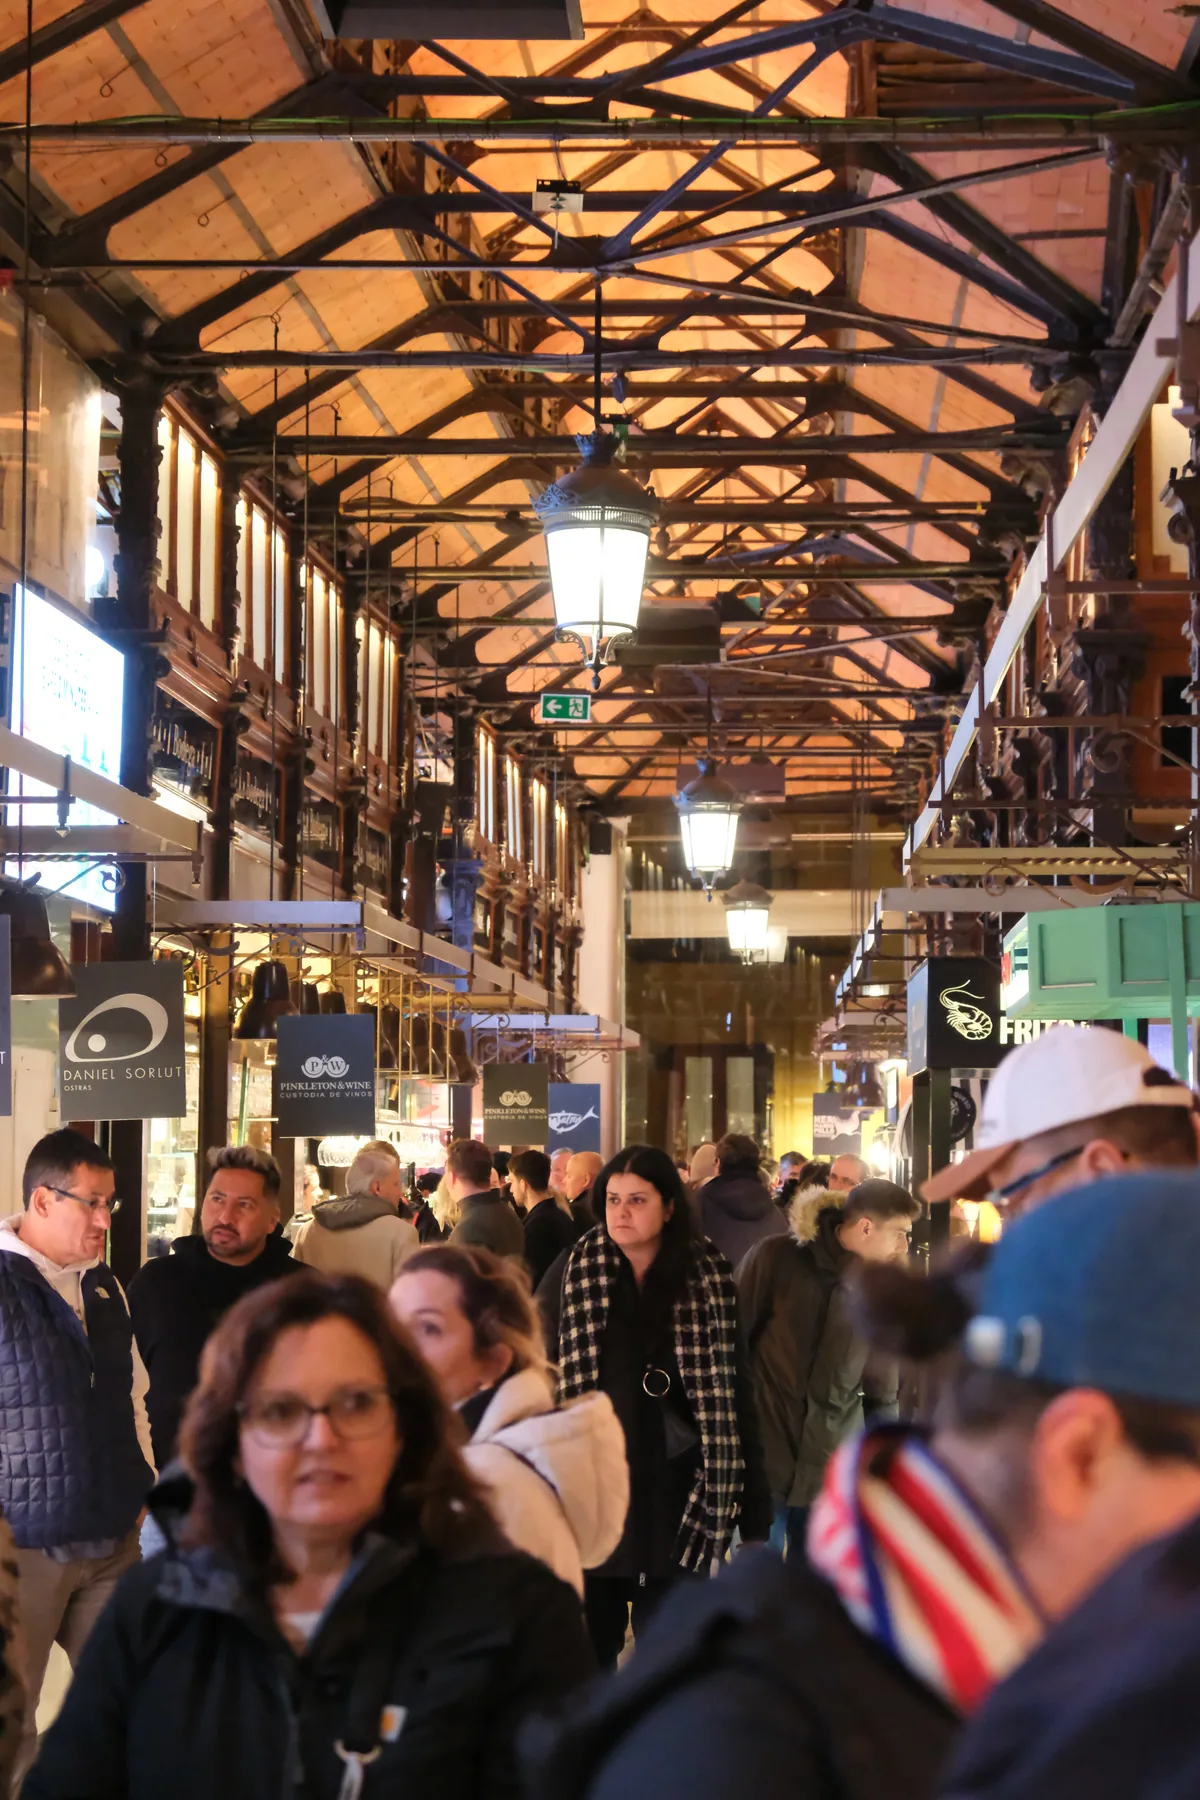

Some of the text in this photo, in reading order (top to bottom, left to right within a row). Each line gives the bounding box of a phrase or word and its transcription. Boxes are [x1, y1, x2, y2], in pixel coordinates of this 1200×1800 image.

[63, 1066, 182, 1081] DANIEL SORLUT
[63, 1084, 92, 1092] OSTRAS
[280, 1081, 371, 1091] PINKLETON&WINE
